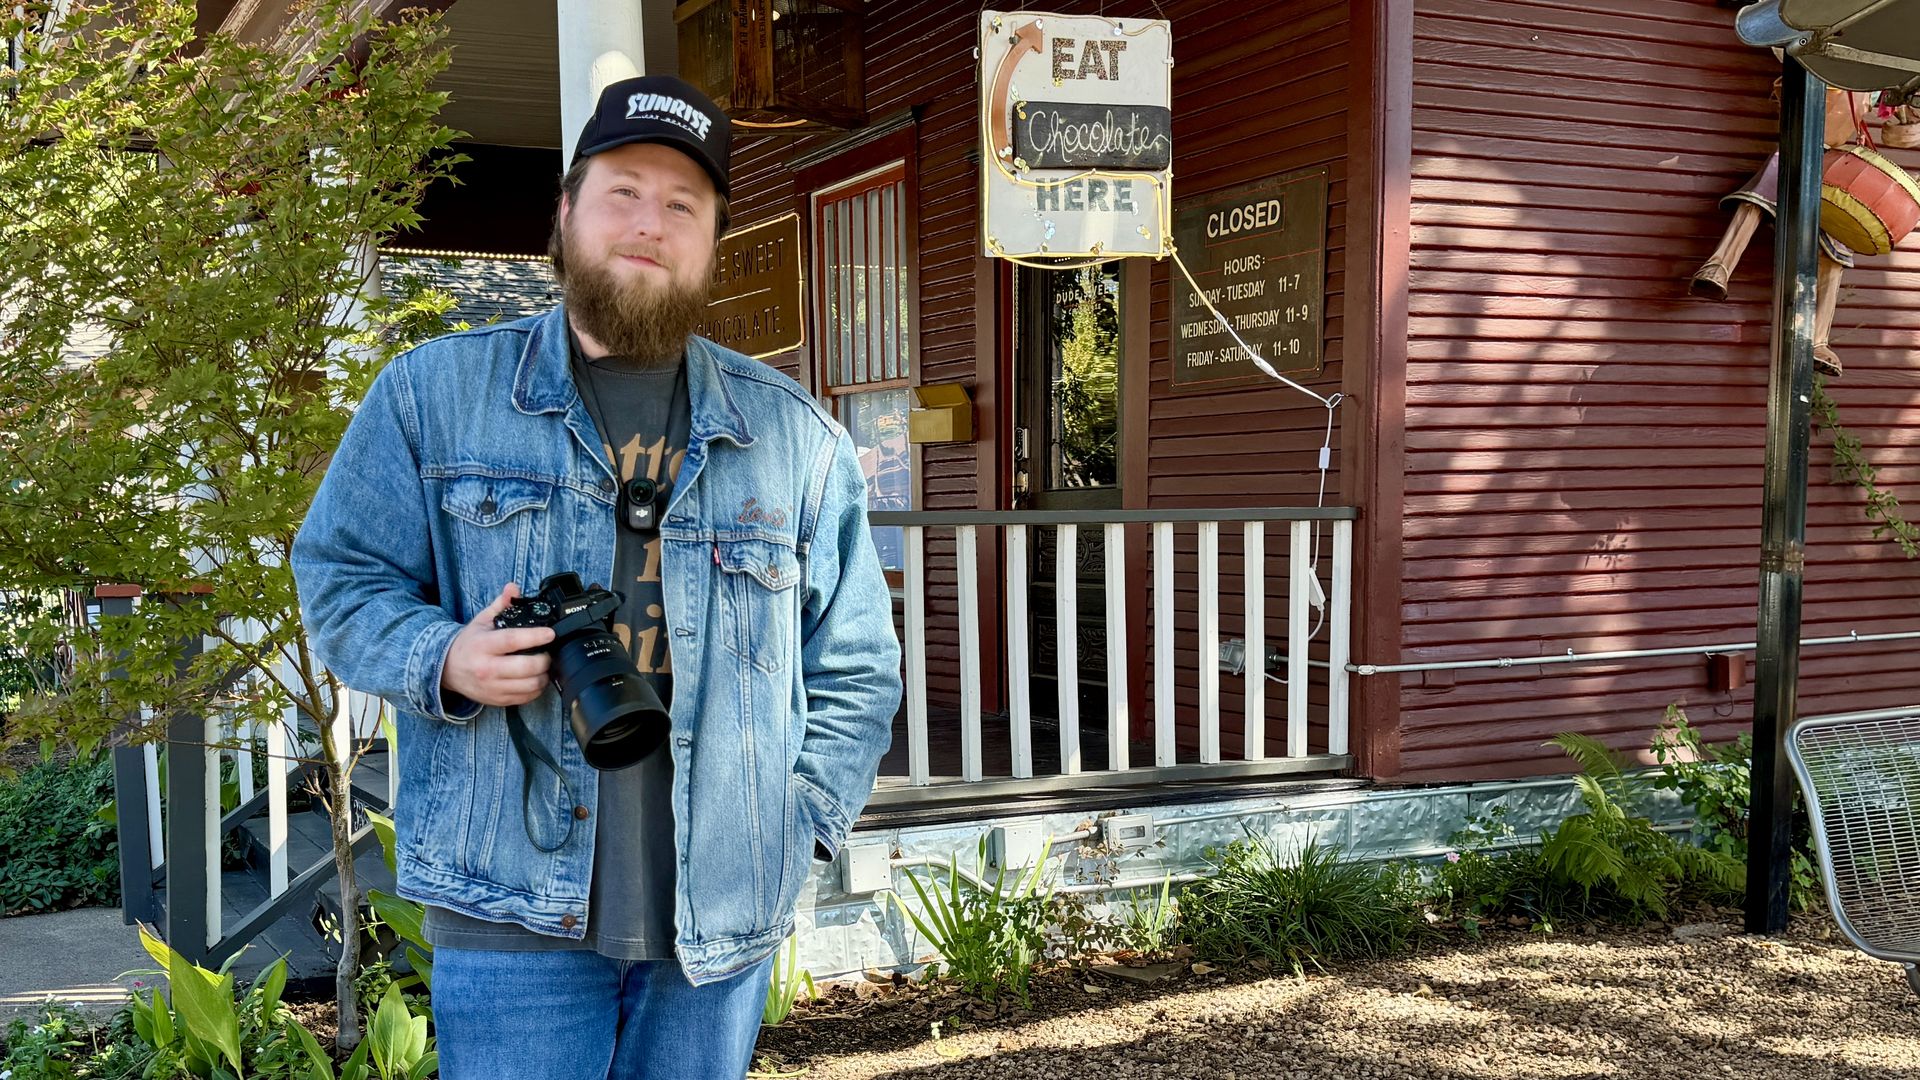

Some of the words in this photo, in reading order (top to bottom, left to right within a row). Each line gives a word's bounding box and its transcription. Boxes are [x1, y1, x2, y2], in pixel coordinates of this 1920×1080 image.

[1052, 37, 1127, 81] EAT
[625, 92, 712, 140] SUNRISE
[1029, 109, 1169, 163] Chocolate
[1035, 178, 1134, 212] HERE
[1206, 199, 1281, 238] CLOSED
[732, 237, 784, 281] SWEET
[1223, 254, 1265, 276] HOURS:
[564, 604, 588, 614] SONY
